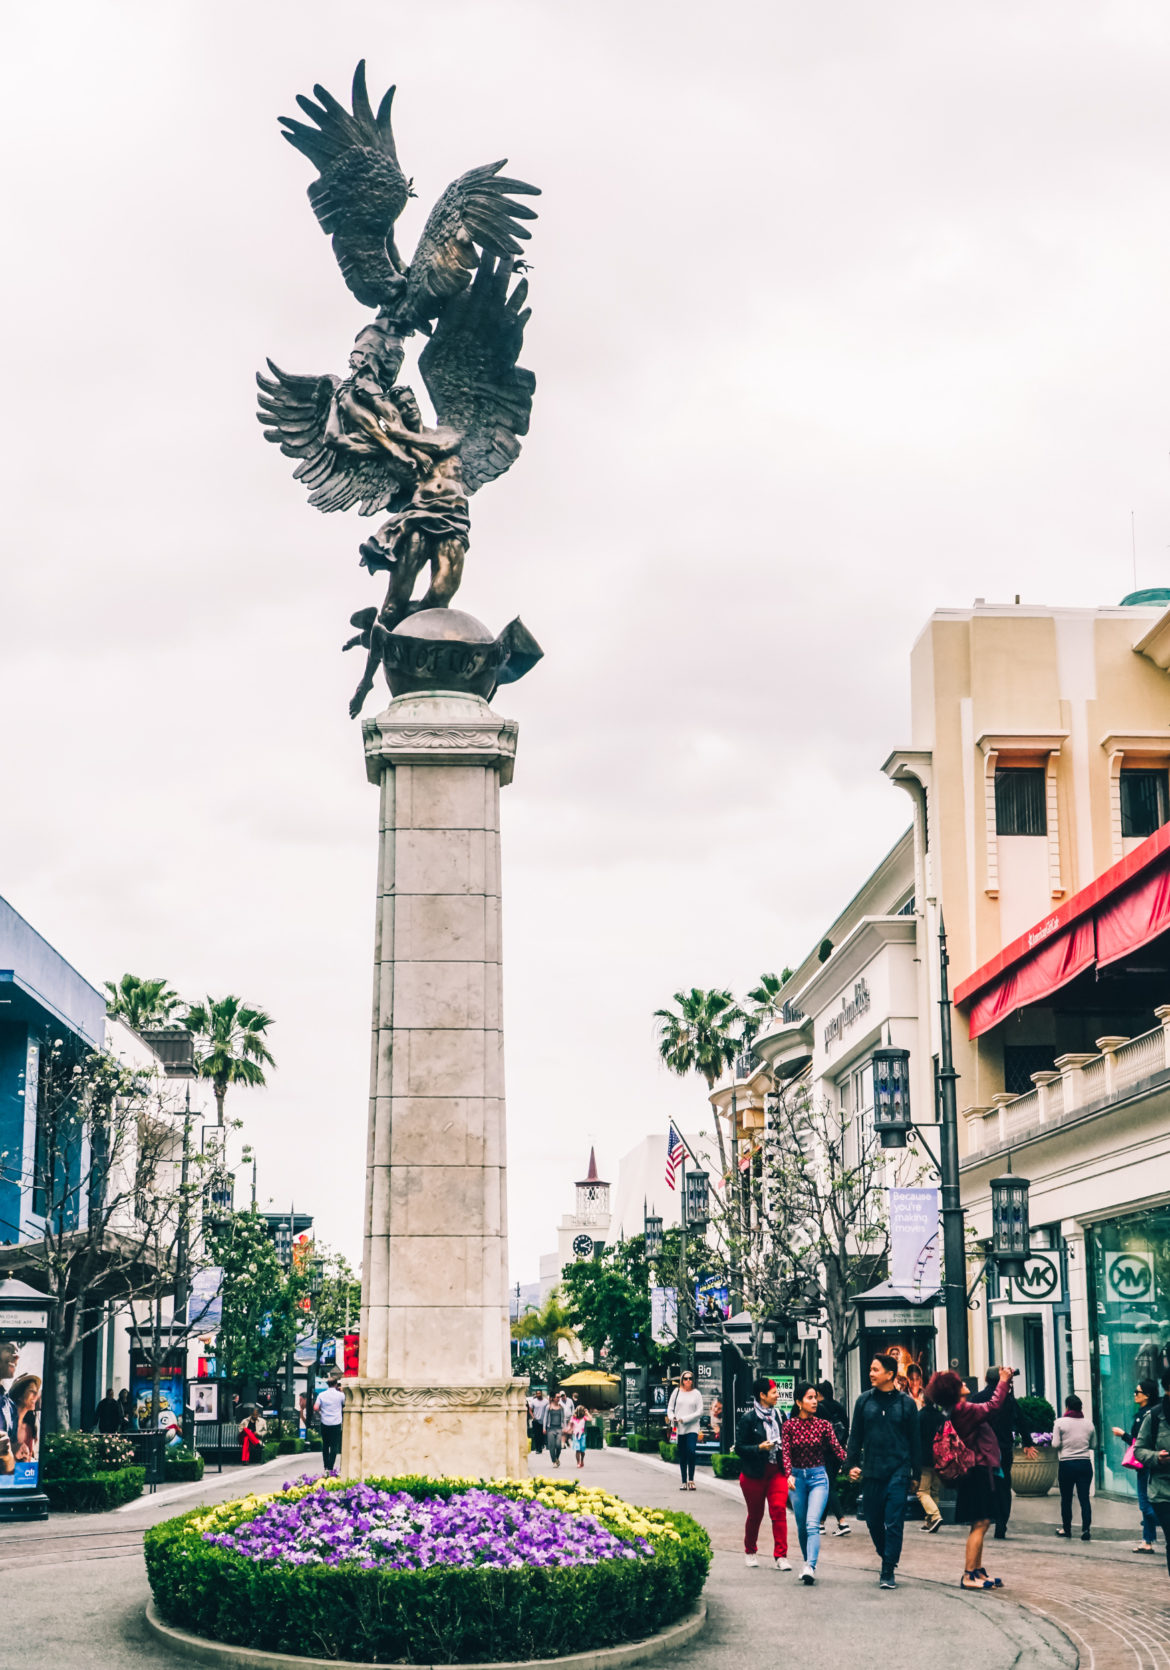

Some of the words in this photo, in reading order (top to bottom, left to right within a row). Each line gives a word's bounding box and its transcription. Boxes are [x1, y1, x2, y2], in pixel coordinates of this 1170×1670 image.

[893, 1191, 932, 1200] Because
[894, 1202, 922, 1213] you're
[895, 1213, 928, 1224] making
[1020, 1266, 1053, 1287] MK
[698, 1365, 712, 1377] Big
[626, 1378, 636, 1387] Big
[776, 1382, 793, 1390] K-182
